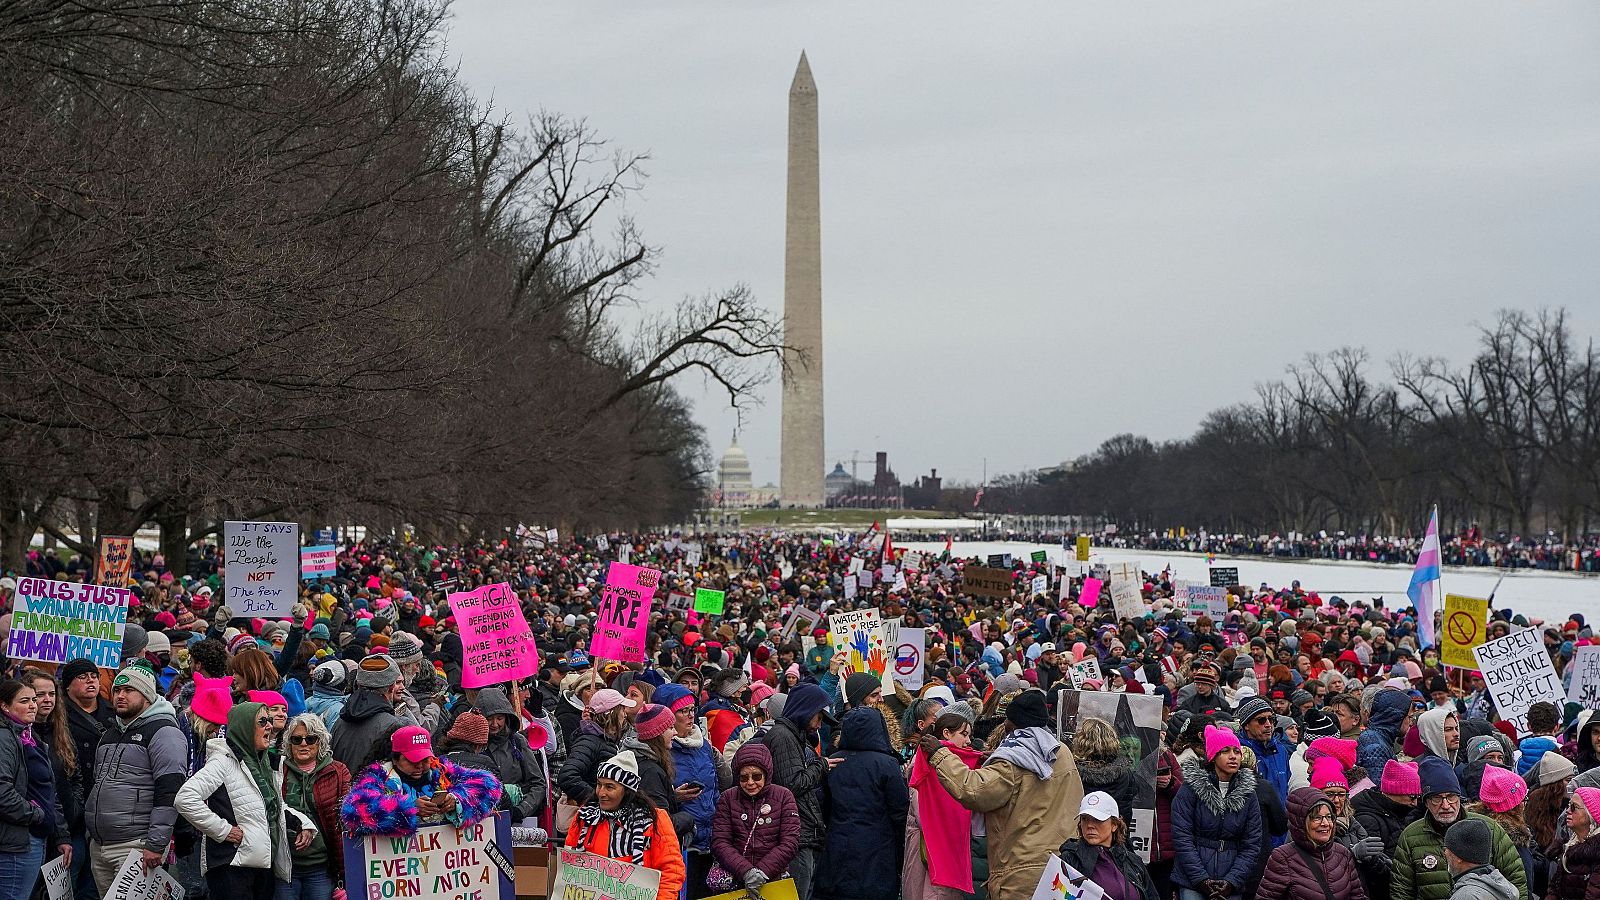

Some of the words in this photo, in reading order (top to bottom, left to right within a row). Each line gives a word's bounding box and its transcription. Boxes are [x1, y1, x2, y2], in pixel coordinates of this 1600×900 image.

[242, 523, 260, 532] IT
[264, 523, 292, 534] SAYS
[231, 535, 251, 547] We
[256, 535, 274, 549] the
[228, 549, 278, 569] People
[18, 578, 75, 600] GIRLS
[78, 584, 130, 606] JUST
[230, 586, 254, 598] The
[612, 586, 641, 599] WOMEN
[966, 577, 1011, 592] UNITED
[25, 595, 86, 620] WANNA
[87, 602, 128, 624] HAVE
[243, 598, 278, 613] Rich
[456, 597, 480, 609] HERE
[600, 594, 641, 629] ARE
[468, 609, 515, 626] DEFENDING
[833, 612, 863, 625] WATCH
[475, 621, 509, 635] WOMEN
[836, 626, 848, 634] US
[860, 620, 879, 630] RISE
[7, 629, 69, 662] HUMAN
[66, 636, 123, 668] RIGHTS
[467, 640, 490, 654] MAYBE
[497, 634, 518, 647] PICK
[622, 645, 640, 654] YOUR
[1477, 628, 1538, 662] RESPECT
[468, 647, 516, 666] SECRETARY
[1506, 650, 1518, 661] MY
[475, 658, 519, 676] DEFENSE!
[1486, 651, 1549, 685] EXISTENCE
[1515, 675, 1530, 686] OR
[1497, 674, 1553, 708] EXPECT
[371, 836, 377, 855] I
[389, 831, 442, 855] WALK
[456, 823, 484, 846] FOR
[369, 855, 430, 879] EVERY
[444, 847, 480, 870] GIRL
[560, 849, 635, 883] DESTROY
[368, 877, 421, 900] BORN
[432, 869, 470, 894] INTO
[479, 865, 490, 884] A
[562, 864, 657, 900] PATRIARCHY
[563, 884, 596, 900] NOT
